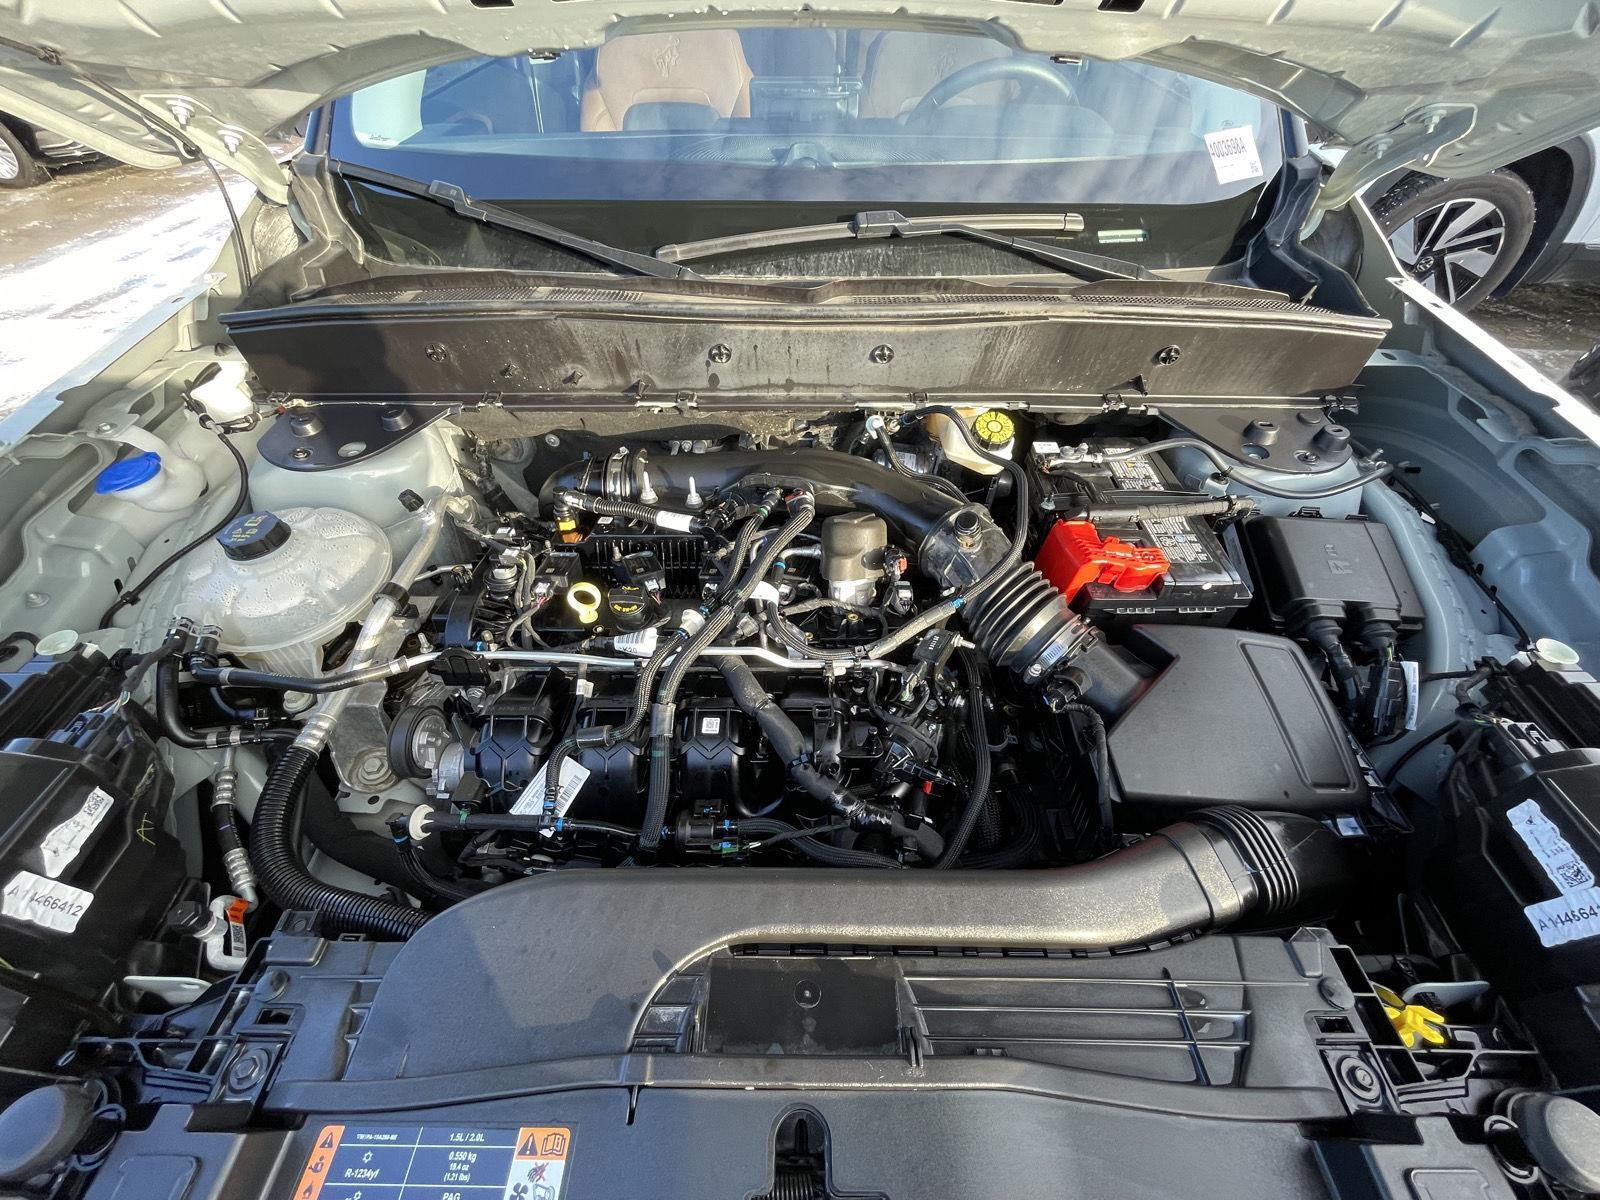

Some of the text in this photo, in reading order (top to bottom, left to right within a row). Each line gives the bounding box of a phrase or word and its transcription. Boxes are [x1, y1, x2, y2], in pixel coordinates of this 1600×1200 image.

[449, 1133, 464, 1142] 1.5L
[469, 1133, 485, 1142] 2.0L
[448, 1151, 477, 1163] 0.550 kg
[344, 1168, 380, 1181] R-1234yf
[442, 1192, 461, 1200] PAG
